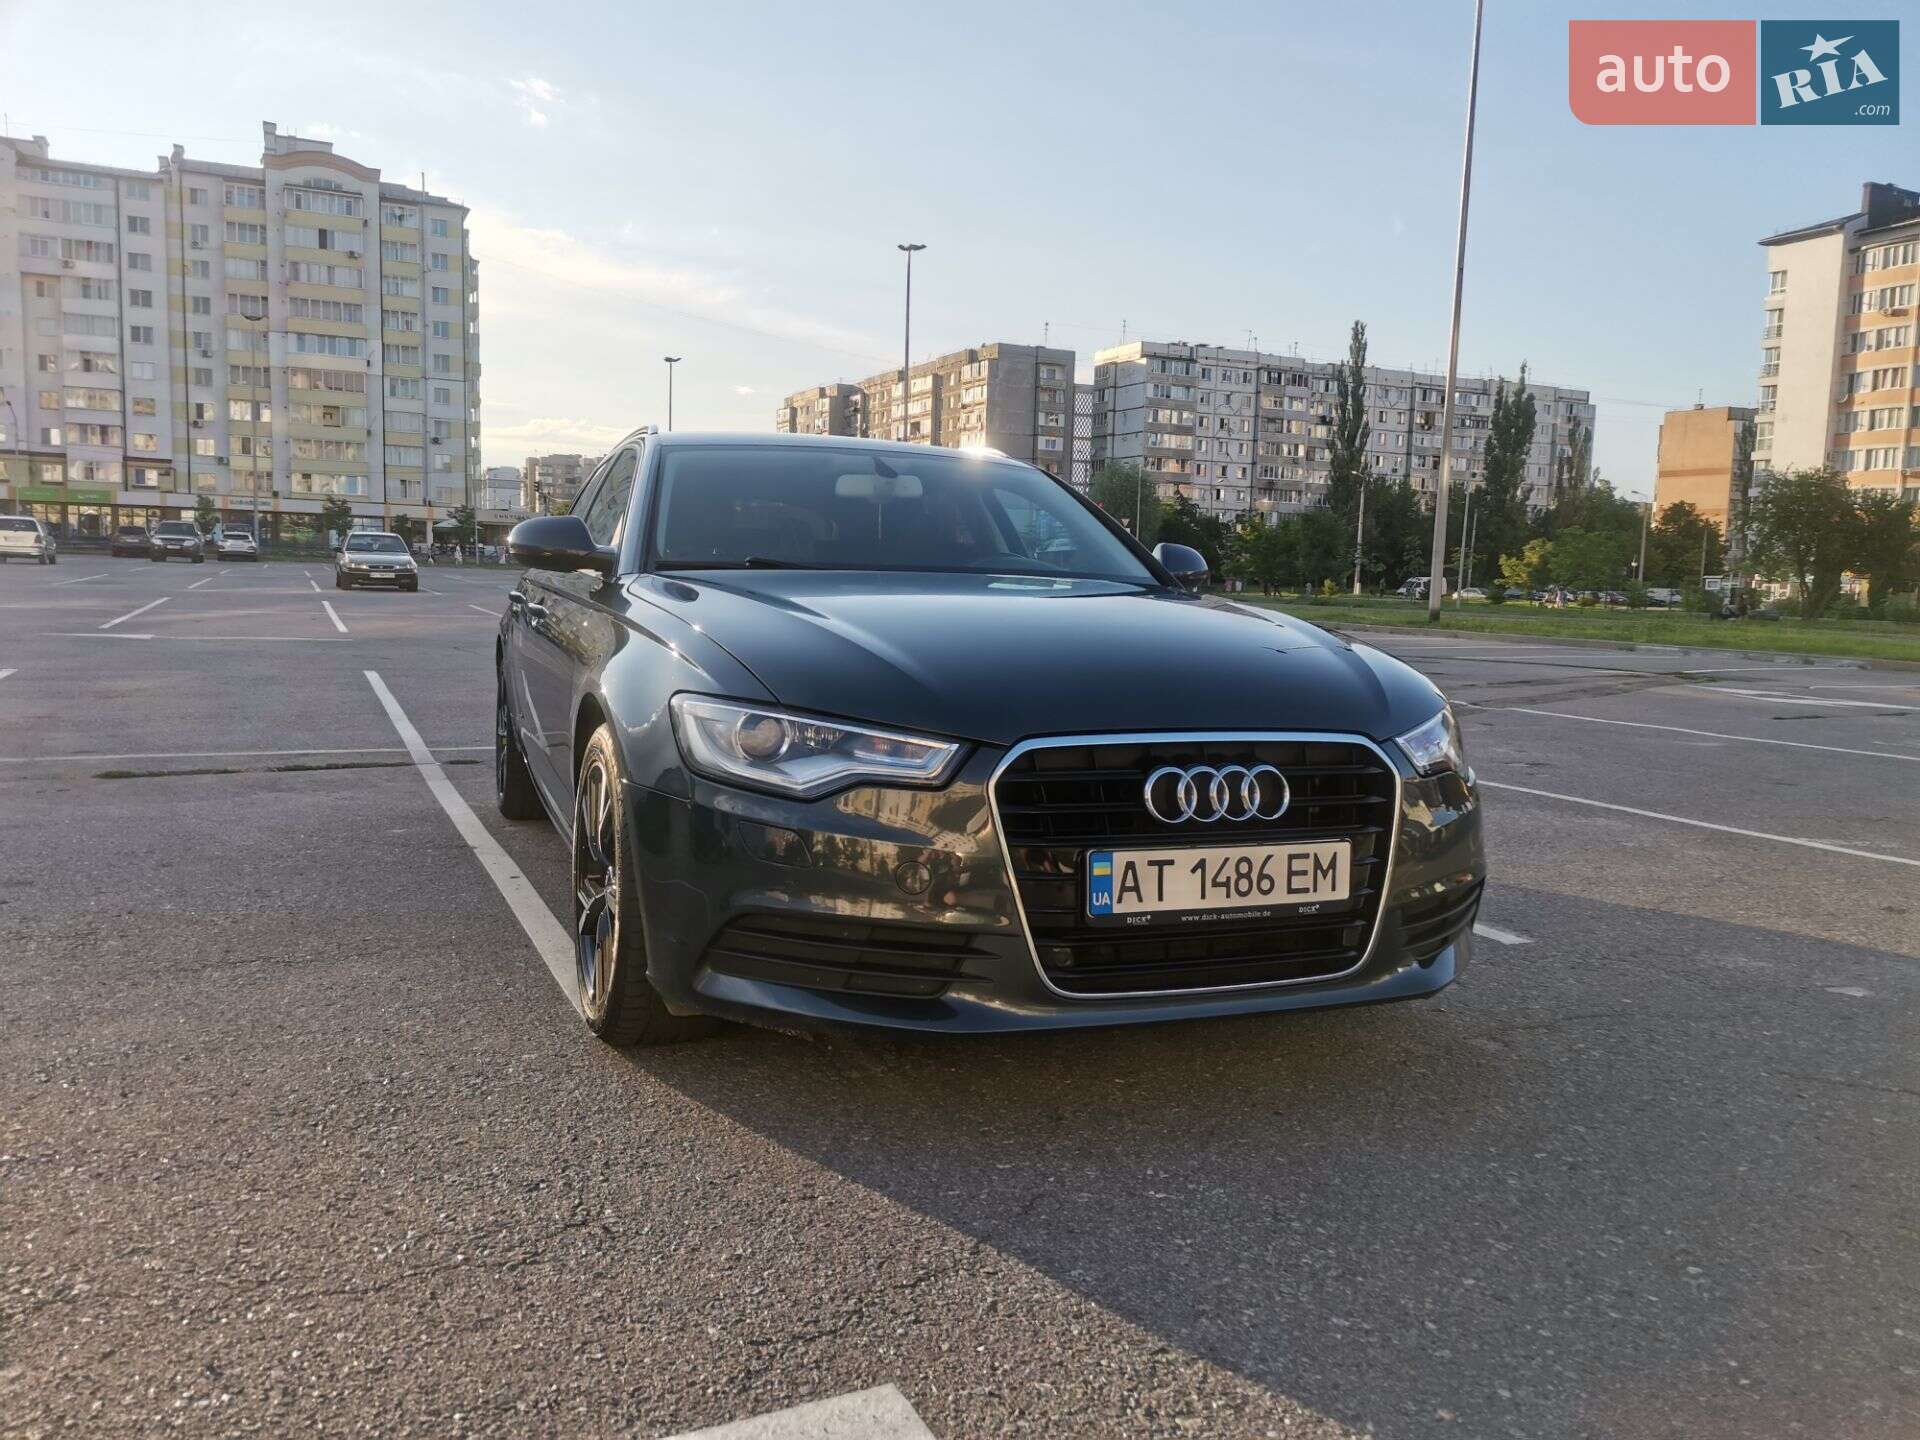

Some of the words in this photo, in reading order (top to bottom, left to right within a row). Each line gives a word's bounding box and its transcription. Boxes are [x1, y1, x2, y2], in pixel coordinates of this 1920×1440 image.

[1116, 859, 1175, 904] AT
[1190, 854, 1275, 900] 1486
[1286, 851, 1338, 895] EM
[1092, 891, 1111, 906] UA
